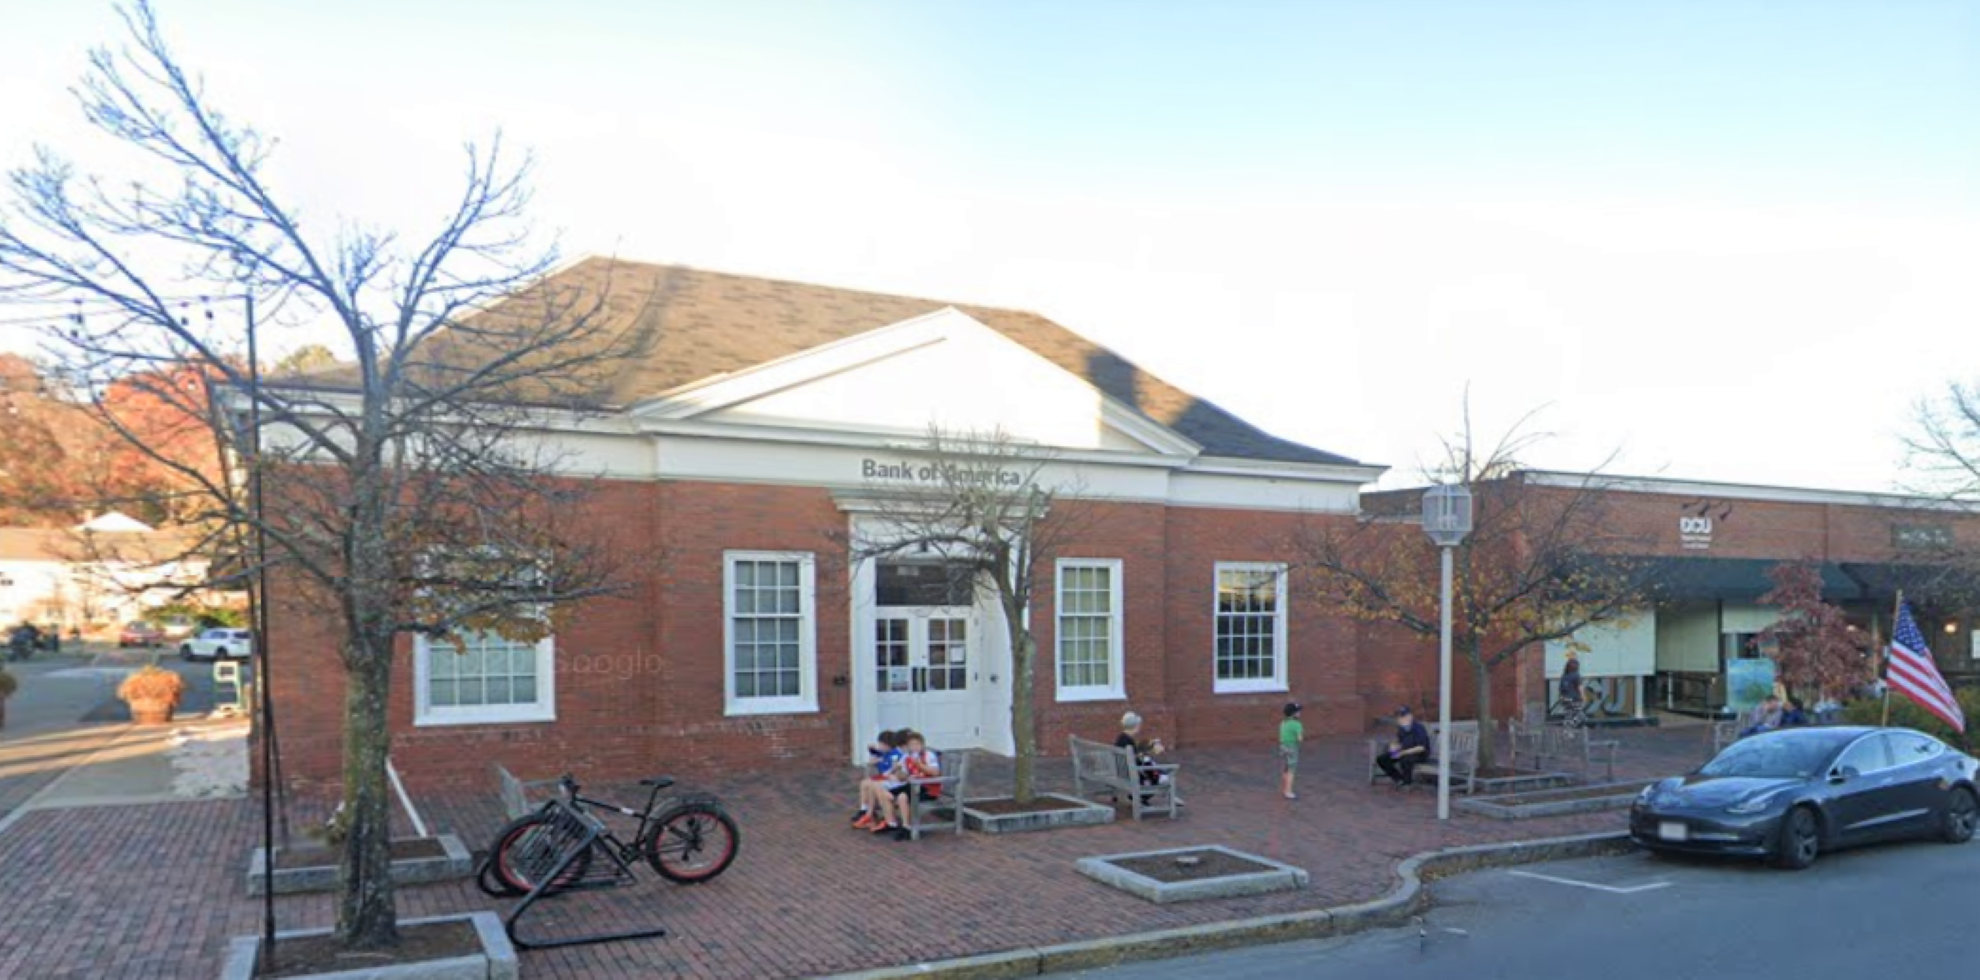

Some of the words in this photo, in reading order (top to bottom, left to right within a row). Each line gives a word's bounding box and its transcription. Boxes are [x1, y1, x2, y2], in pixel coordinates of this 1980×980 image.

[862, 459, 912, 480] Bank
[918, 465, 938, 482] of
[944, 464, 1021, 486] America
[1680, 516, 1713, 533] DCU
